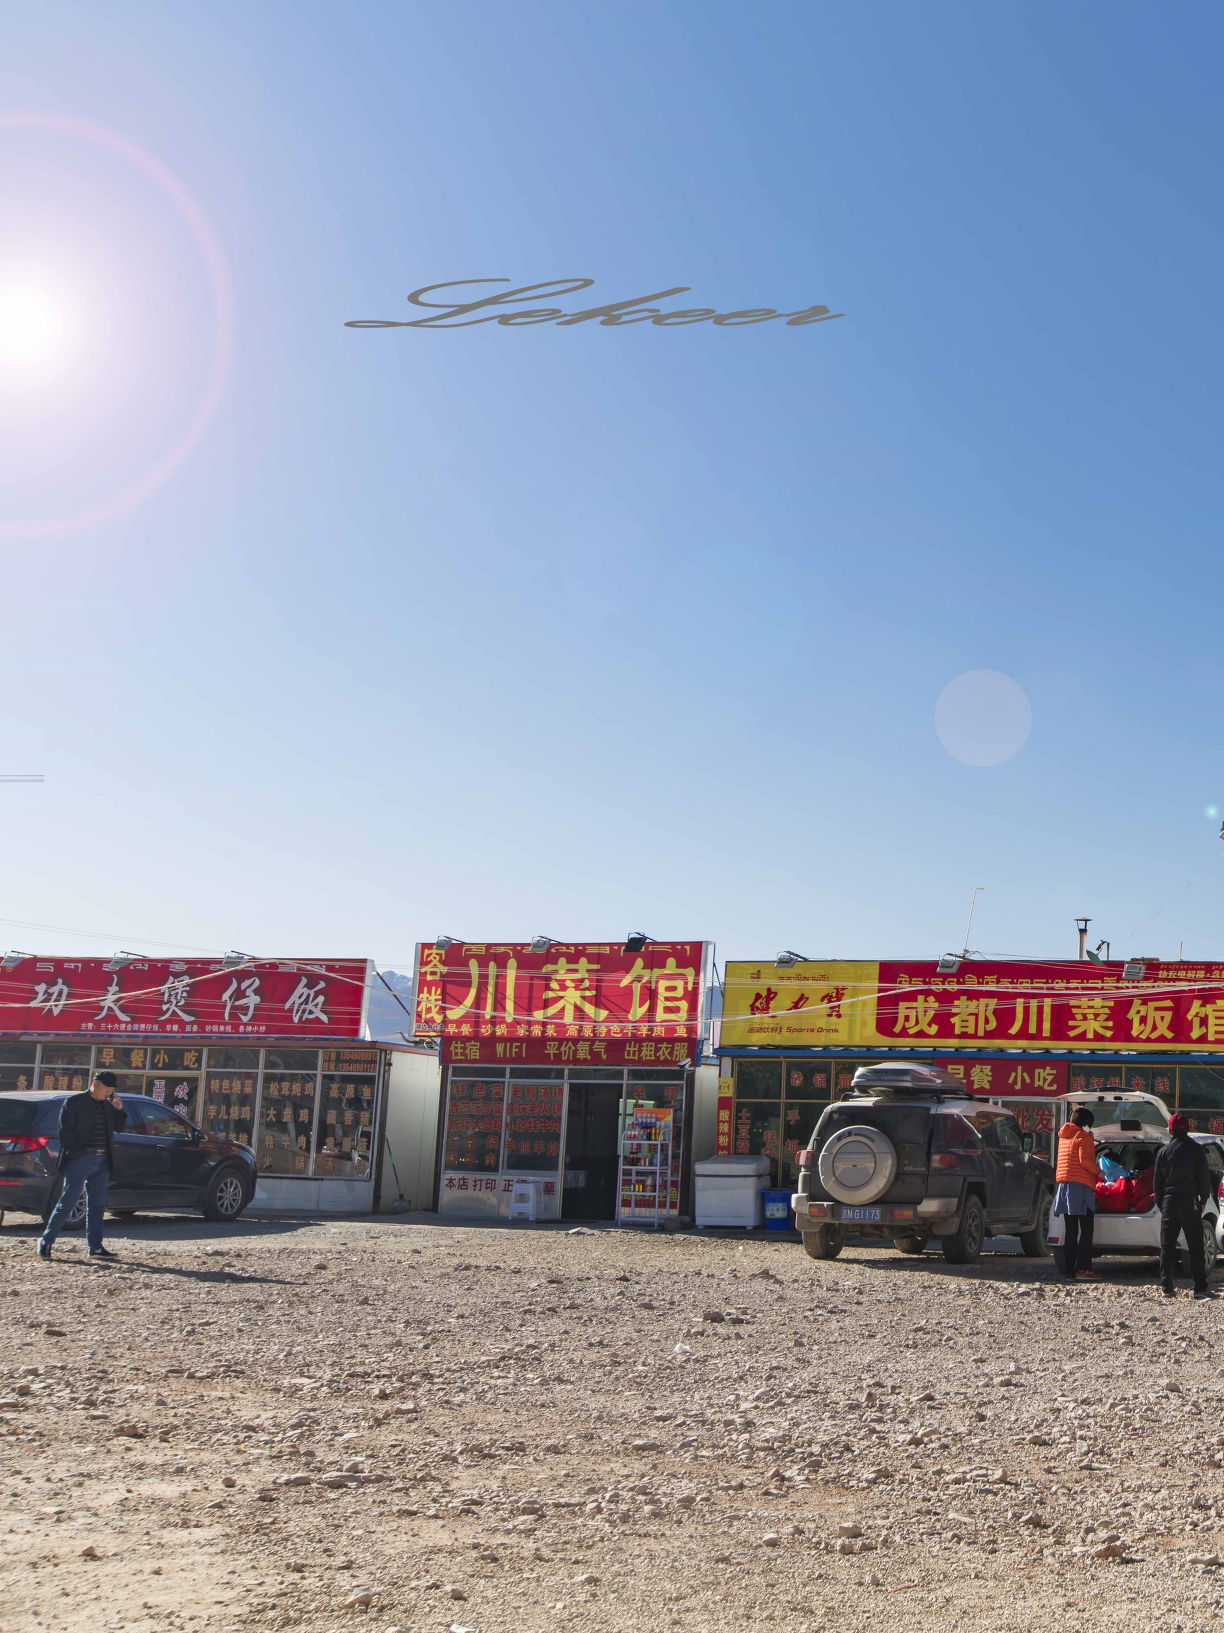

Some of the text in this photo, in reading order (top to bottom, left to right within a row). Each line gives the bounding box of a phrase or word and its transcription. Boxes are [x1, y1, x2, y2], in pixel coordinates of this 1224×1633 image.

[416, 945, 448, 1023] 客栈
[446, 956, 695, 1023] 川菜馆
[30, 973, 329, 1023] 功夫煲仔饭
[445, 1023, 472, 1036] 早餐
[565, 1025, 665, 1037] 高原特色牛羊肉
[674, 1026, 688, 1037] 鱼
[786, 1026, 814, 1034] Sports
[449, 1041, 688, 1060] 住宿 WIFI 平价氧气 出租衣服
[1008, 1066, 1057, 1090] 小吃
[445, 1176, 469, 1192] 本店
[473, 1177, 497, 1192] 打印
